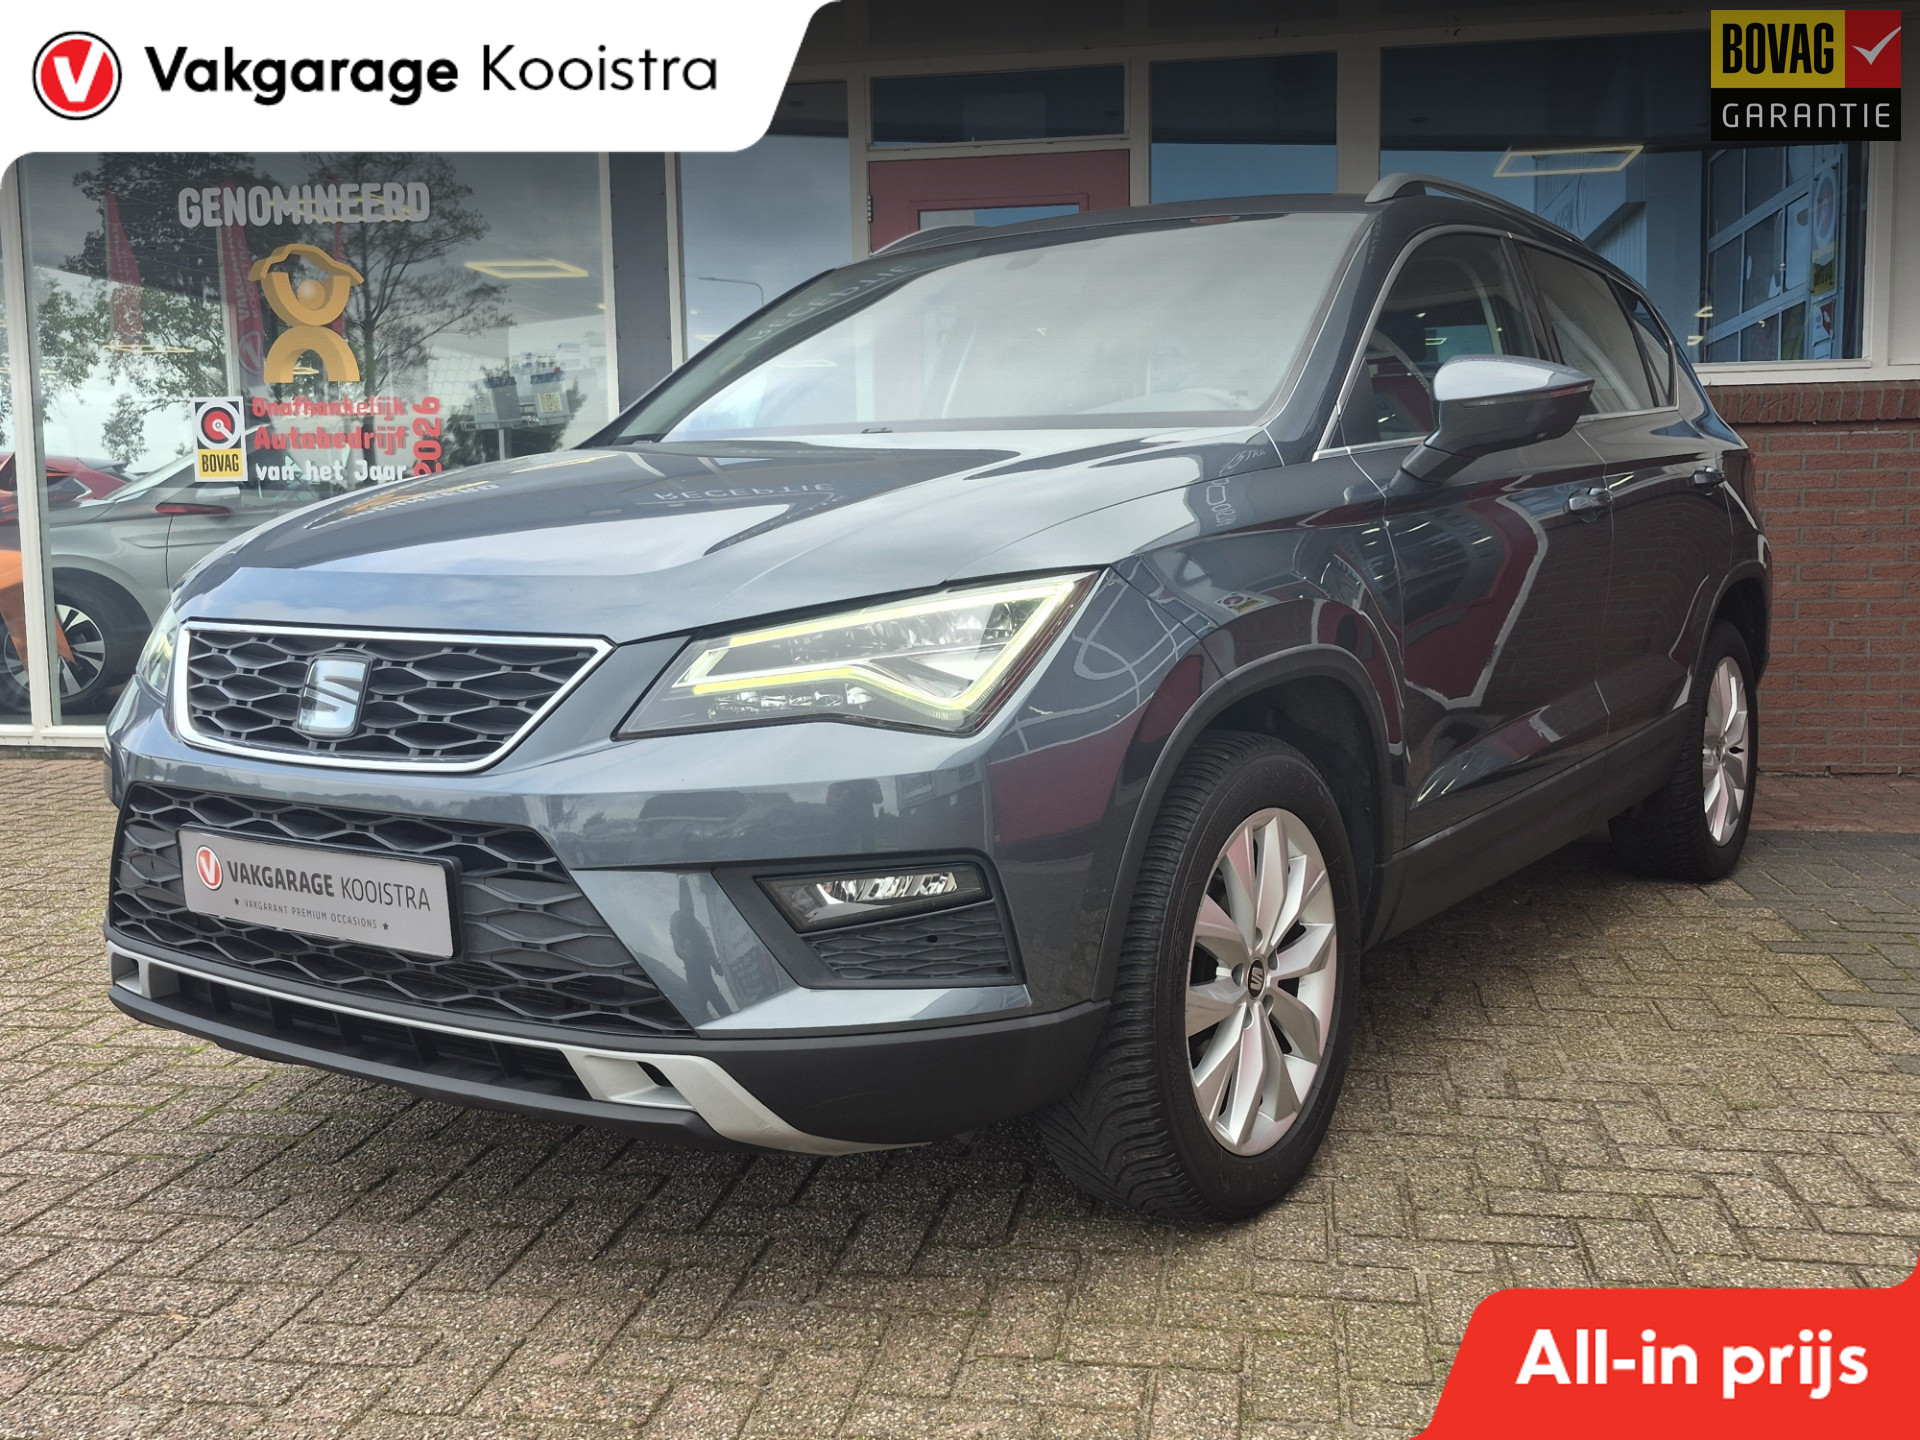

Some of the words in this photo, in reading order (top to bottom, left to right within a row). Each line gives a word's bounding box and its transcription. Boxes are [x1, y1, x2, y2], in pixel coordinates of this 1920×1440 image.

[178, 182, 431, 228] GENOMINEERD
[251, 396, 406, 421] Onafhankelijk
[254, 425, 408, 456] Autobedrijf
[202, 454, 240, 473] BOVAG
[255, 463, 295, 481] van
[305, 460, 344, 481] het
[354, 459, 407, 481] Jaar
[227, 860, 335, 898] VAKGARAGE
[340, 876, 432, 912] KOOISTRA
[243, 898, 289, 915] VAKGARANT
[291, 906, 328, 921] PREMIUM
[330, 912, 378, 930] OCCASIONS
